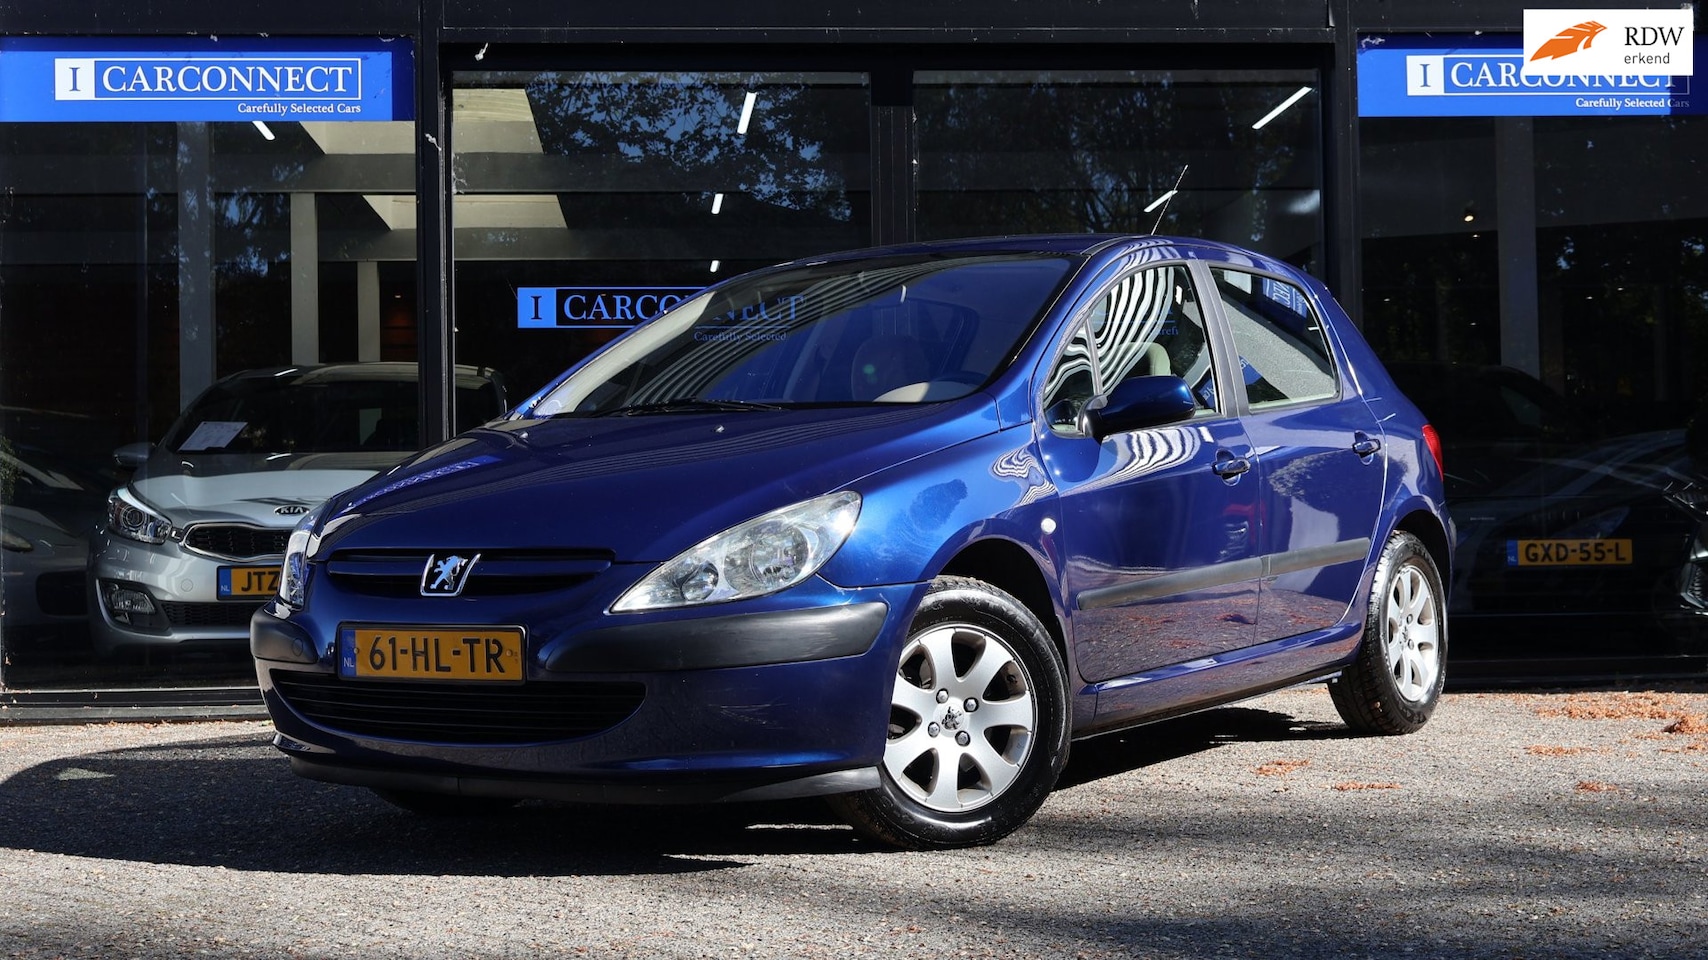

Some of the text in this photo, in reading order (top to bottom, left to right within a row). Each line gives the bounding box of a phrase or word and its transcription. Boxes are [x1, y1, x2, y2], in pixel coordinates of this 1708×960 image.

[102, 66, 353, 93] CARCONNECT
[237, 103, 361, 116] Carefully Selected Cars
[1575, 98, 1690, 110] Carefully Selected Cars
[745, 332, 787, 341] Selected
[280, 505, 304, 514] KIA
[1525, 543, 1626, 562] GXD-55-L
[369, 635, 505, 673] 61-HL-TR
[343, 657, 355, 668] NL
